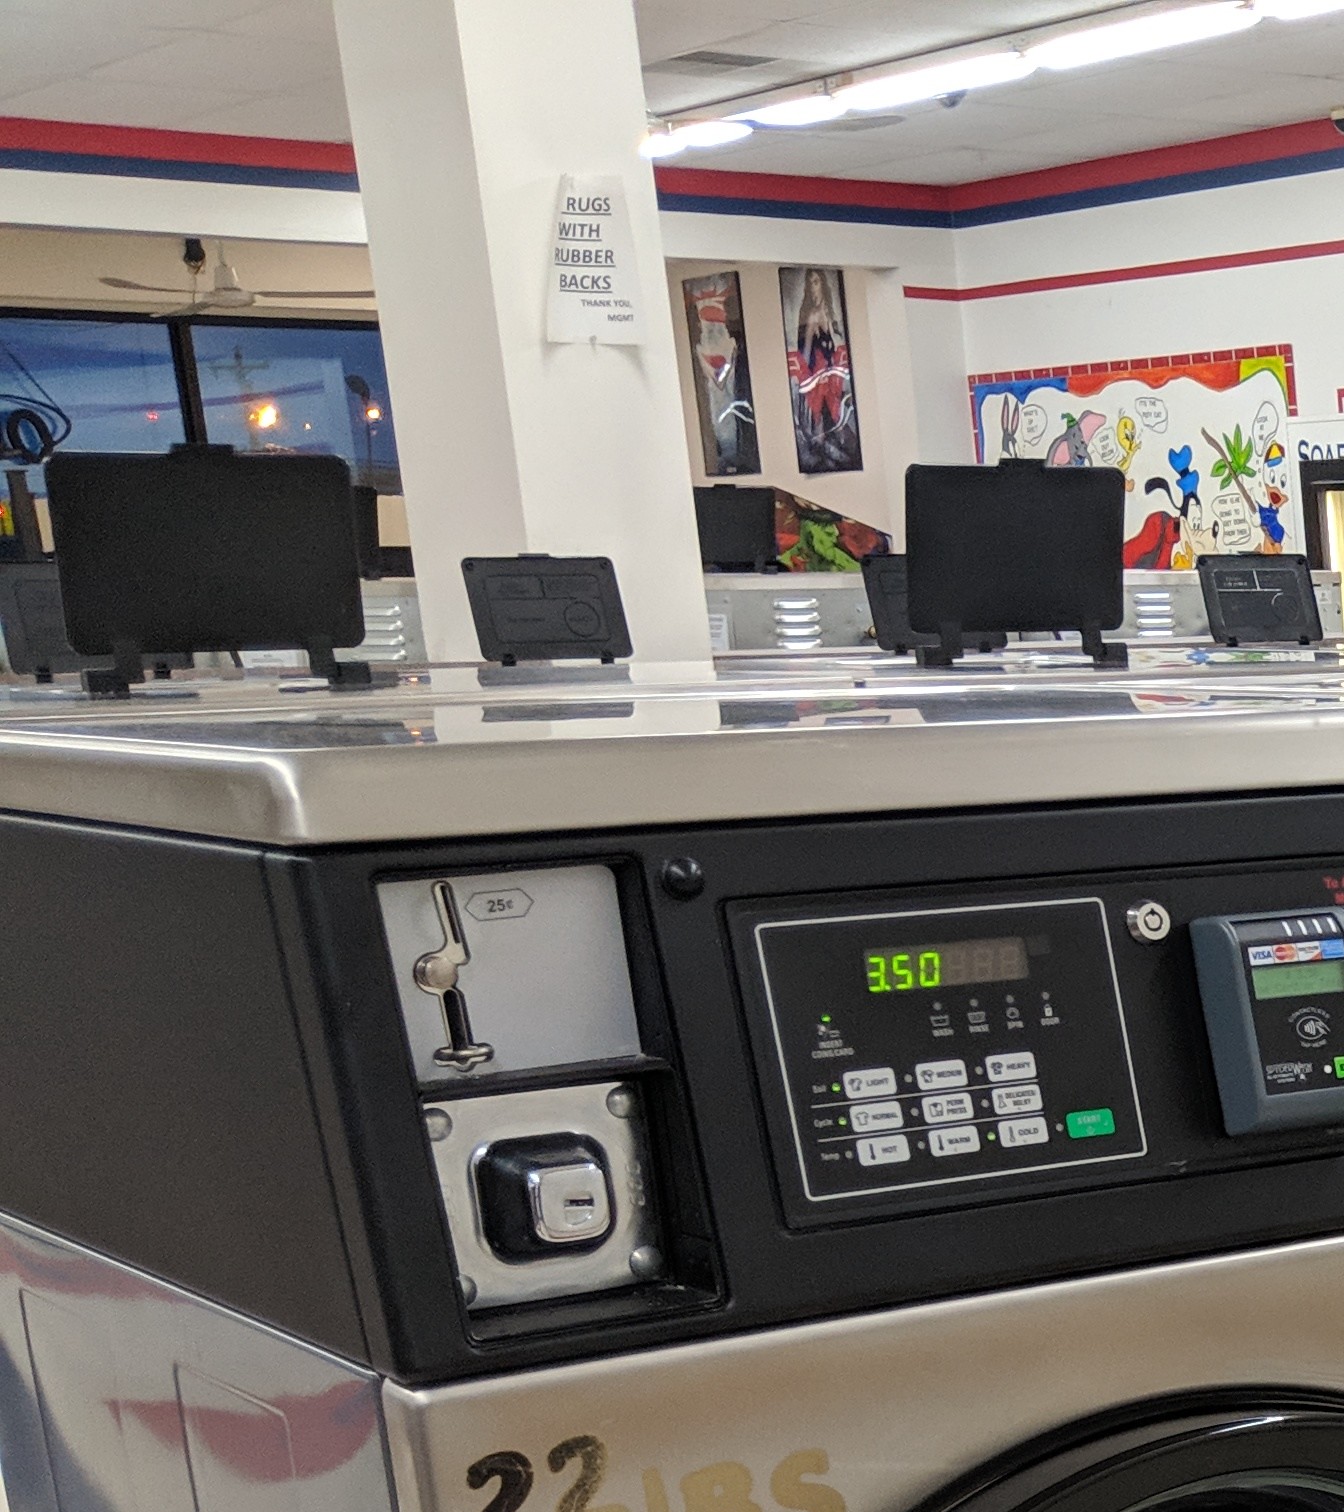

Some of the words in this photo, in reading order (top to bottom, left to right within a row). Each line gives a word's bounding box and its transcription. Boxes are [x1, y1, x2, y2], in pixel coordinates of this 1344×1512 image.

[566, 197, 611, 212] RUGS
[559, 222, 600, 237] WITH
[555, 248, 614, 264] RUBBER
[560, 274, 611, 289] BACKS
[581, 299, 611, 307] THANK
[1325, 878, 1339, 888] To
[1253, 951, 1272, 960] VISA
[867, 952, 941, 992] 3.50
[866, 1078, 889, 1086] LIGHT
[936, 1070, 962, 1078] MEDIUM
[1007, 1062, 1031, 1070] HEAVY
